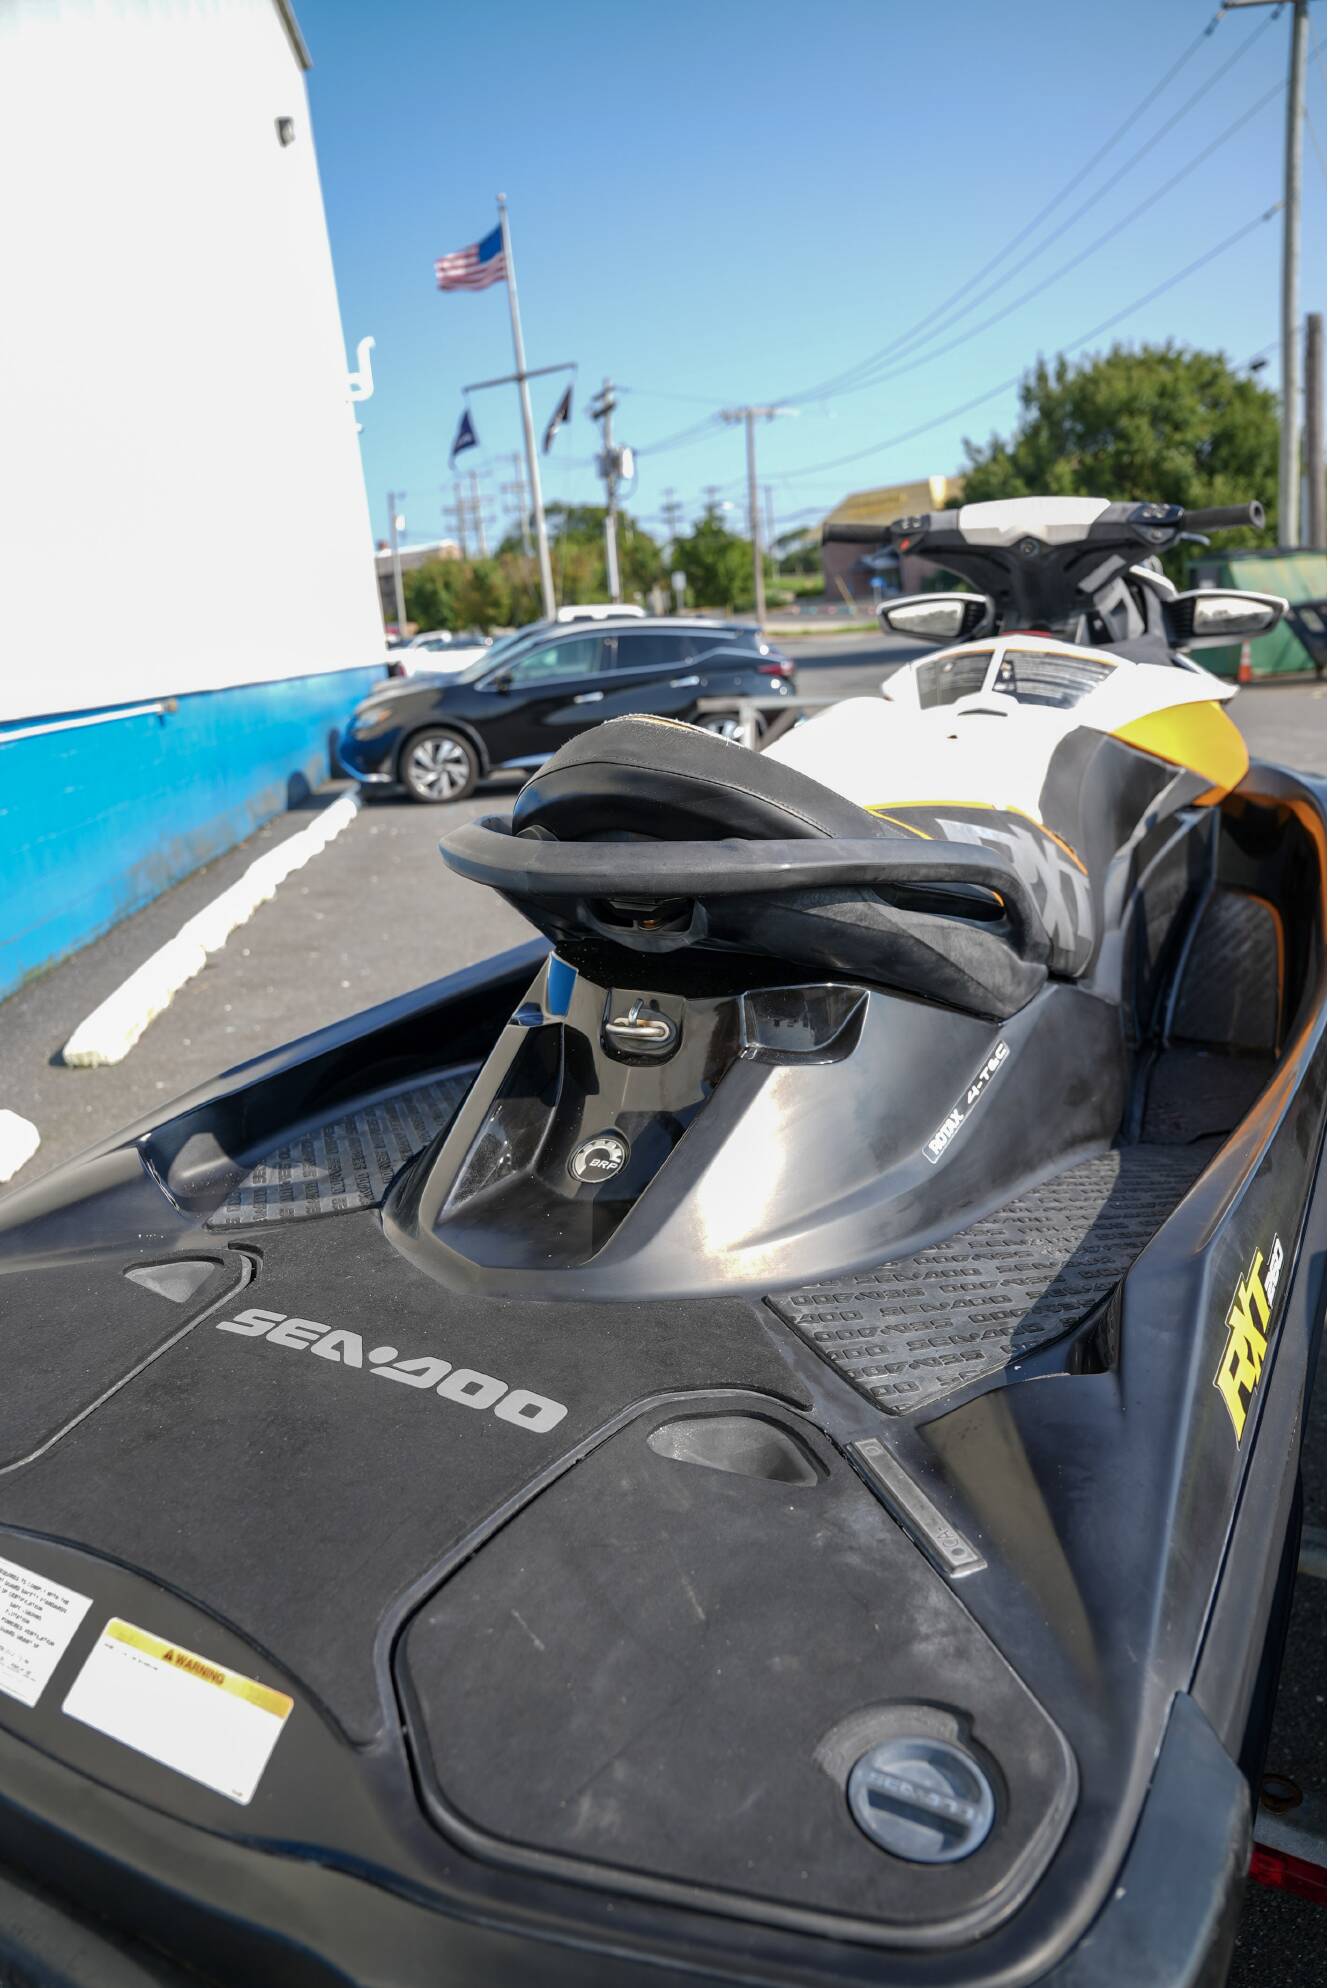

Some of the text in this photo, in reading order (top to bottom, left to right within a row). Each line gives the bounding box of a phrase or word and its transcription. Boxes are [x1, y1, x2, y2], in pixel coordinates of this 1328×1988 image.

[928, 1108, 964, 1155] ROTAX
[588, 1158, 619, 1170] BRP
[1216, 1248, 1272, 1442] RXT
[175, 1652, 226, 1686] WARNING
